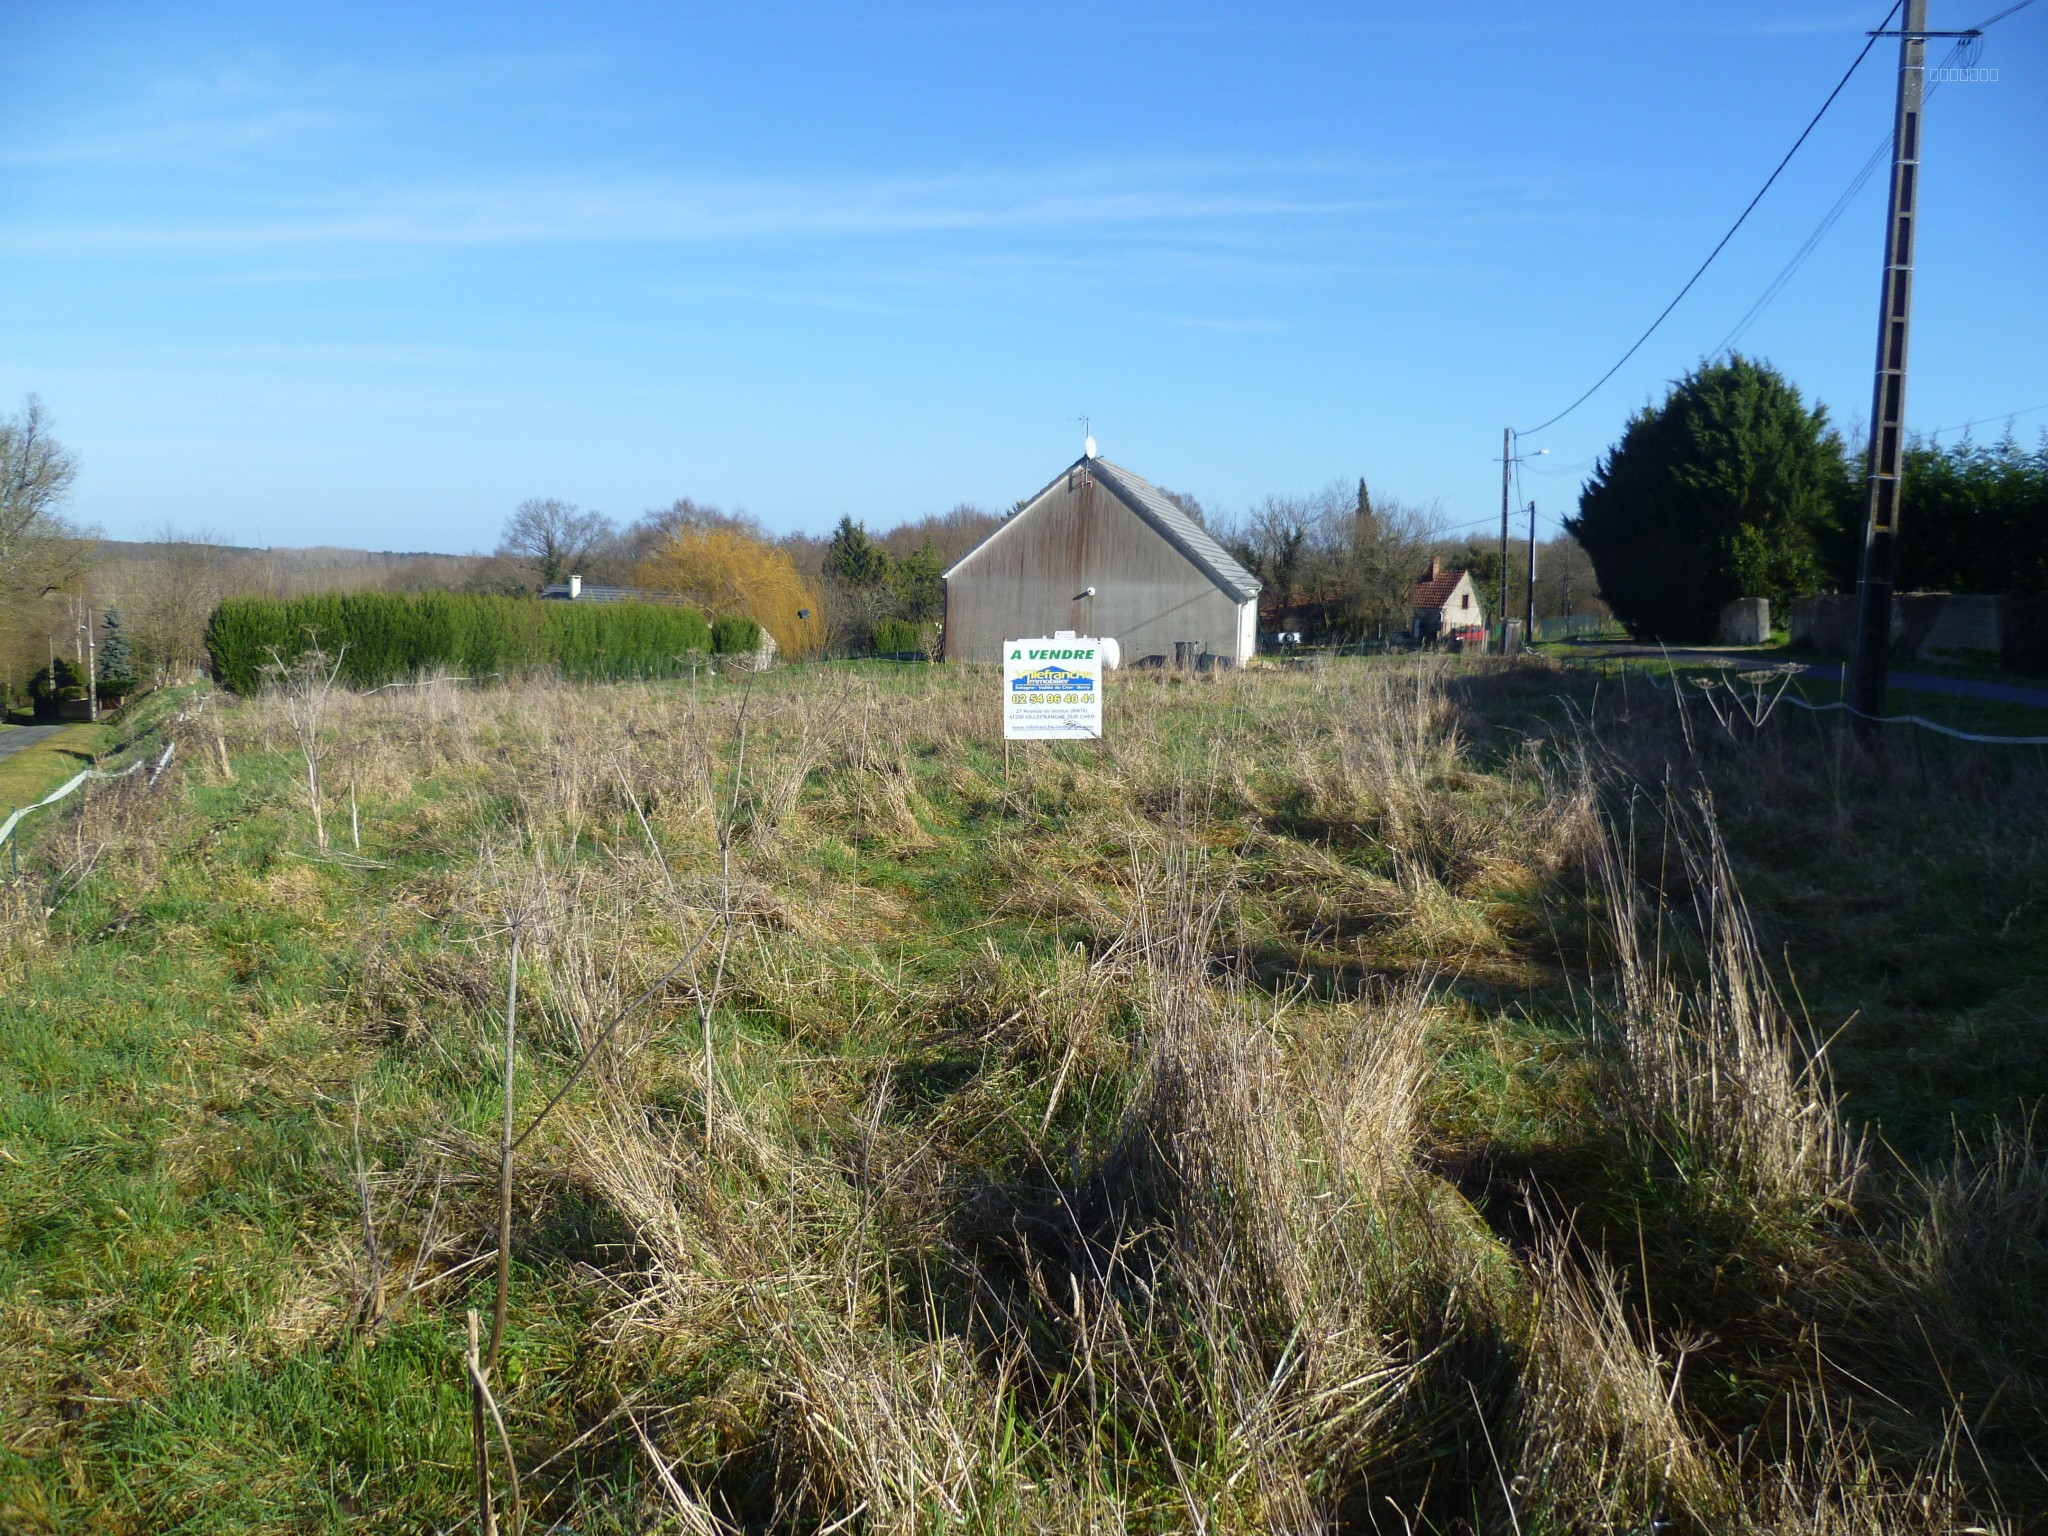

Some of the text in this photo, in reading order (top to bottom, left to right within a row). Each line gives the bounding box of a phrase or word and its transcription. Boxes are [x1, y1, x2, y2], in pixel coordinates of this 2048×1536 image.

[1010, 650, 1095, 660] A VENDRE
[1015, 669, 1093, 680] Villefranche
[1012, 694, 1095, 704] 02 54 96 40 41
